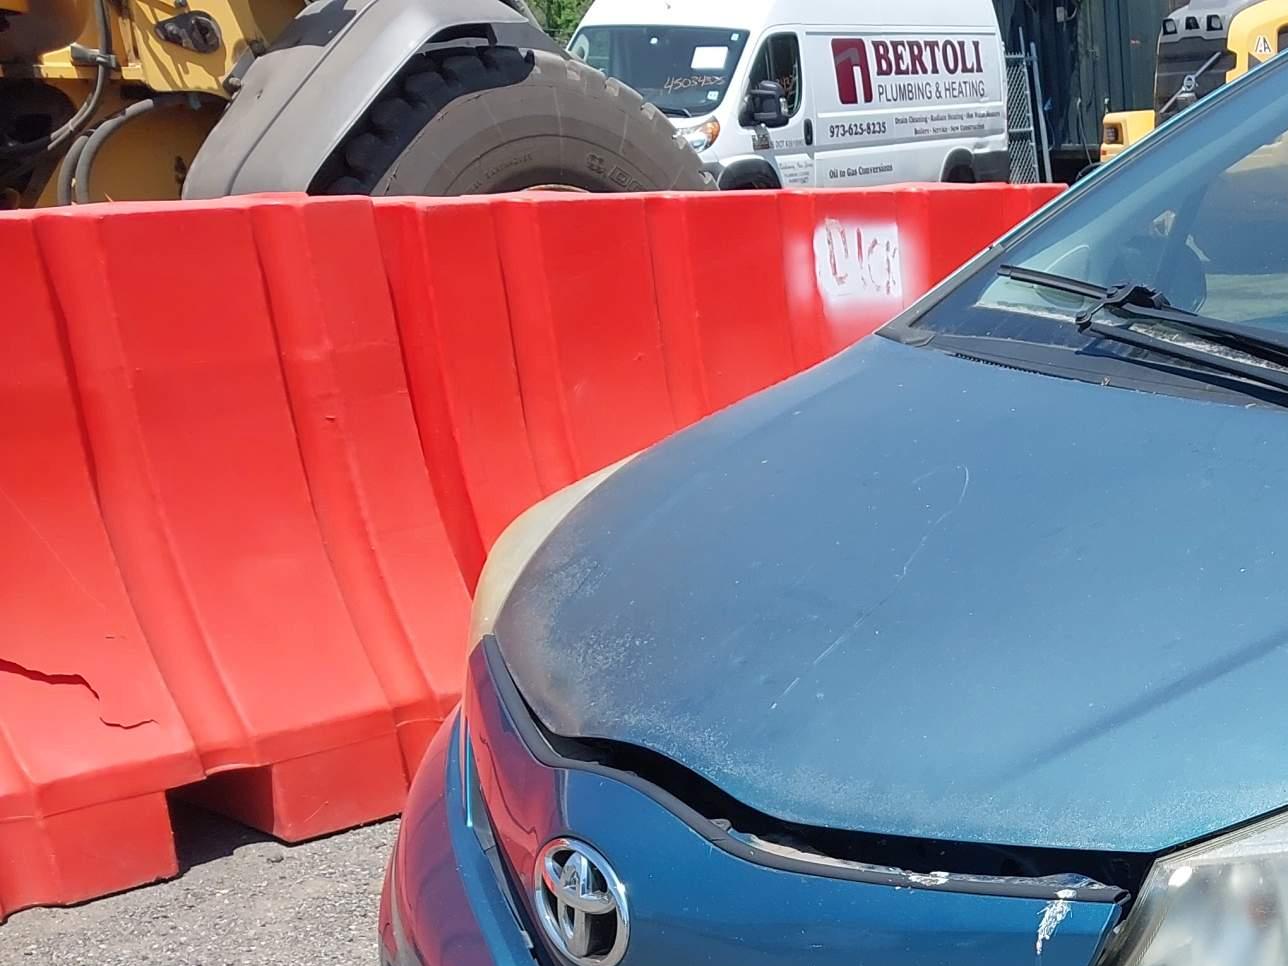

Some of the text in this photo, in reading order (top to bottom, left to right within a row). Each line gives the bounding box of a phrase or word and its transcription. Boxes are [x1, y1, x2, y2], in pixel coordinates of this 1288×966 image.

[872, 39, 983, 76] BERTOLI
[878, 80, 985, 102] PLUMBING & HEATING
[829, 121, 887, 138] 973-625-8235
[829, 164, 893, 178] Oil to Gas Conversions
